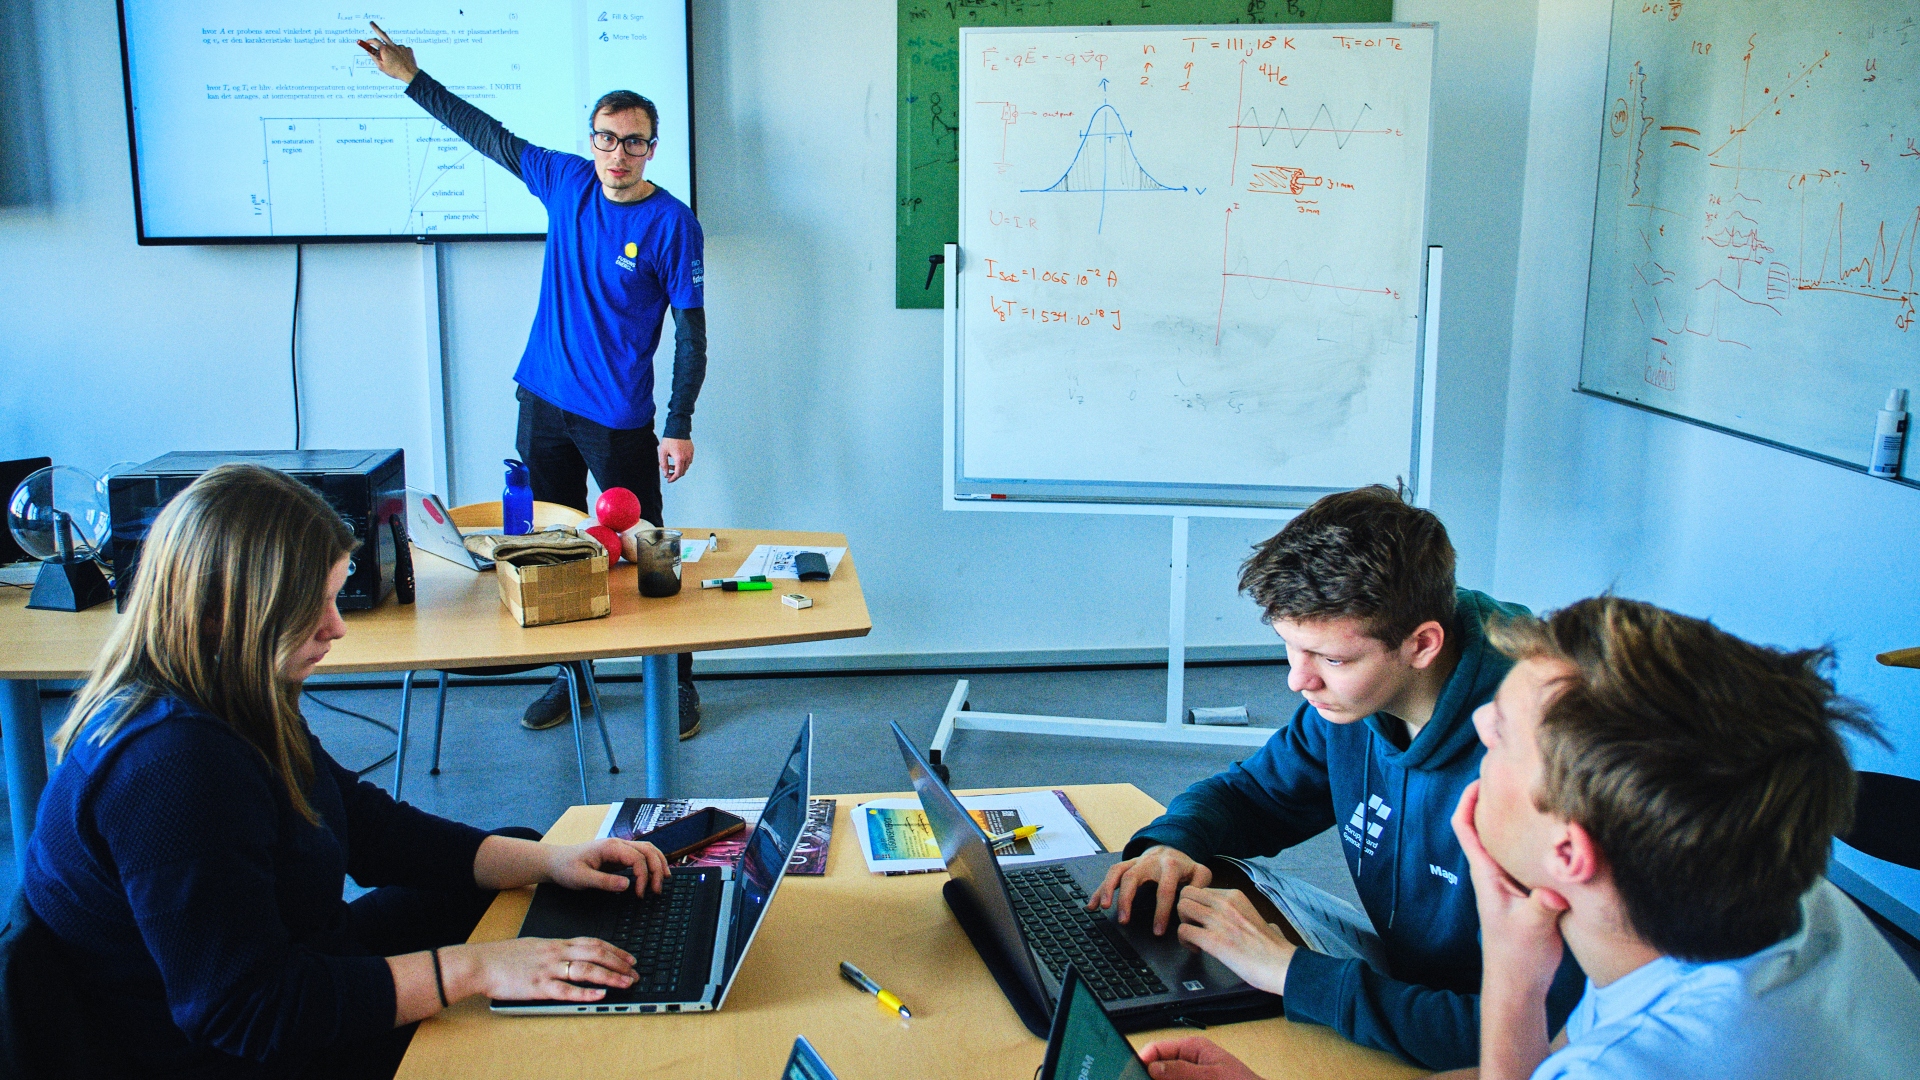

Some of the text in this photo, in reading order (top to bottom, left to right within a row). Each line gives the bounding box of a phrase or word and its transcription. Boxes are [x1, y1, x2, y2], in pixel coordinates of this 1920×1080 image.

[630, 13, 645, 22] Sign
[202, 27, 217, 35] hvor
[237, 27, 263, 36] probens
[265, 27, 281, 35] areal
[283, 27, 312, 35] vinkelret
[314, 27, 323, 36] på
[202, 37, 211, 45] og
[245, 36, 293, 44] karakteristiske
[327, 36, 336, 44] for
[453, 37, 470, 45] givet
[612, 33, 648, 41] More Tools
[358, 123, 367, 132] b)
[271, 137, 315, 145] ion-saturation
[336, 136, 394, 145] exponential region
[437, 144, 458, 153] region
[437, 162, 465, 171] spherical
[431, 188, 465, 197] cylindrical
[444, 212, 480, 221] plane probe
